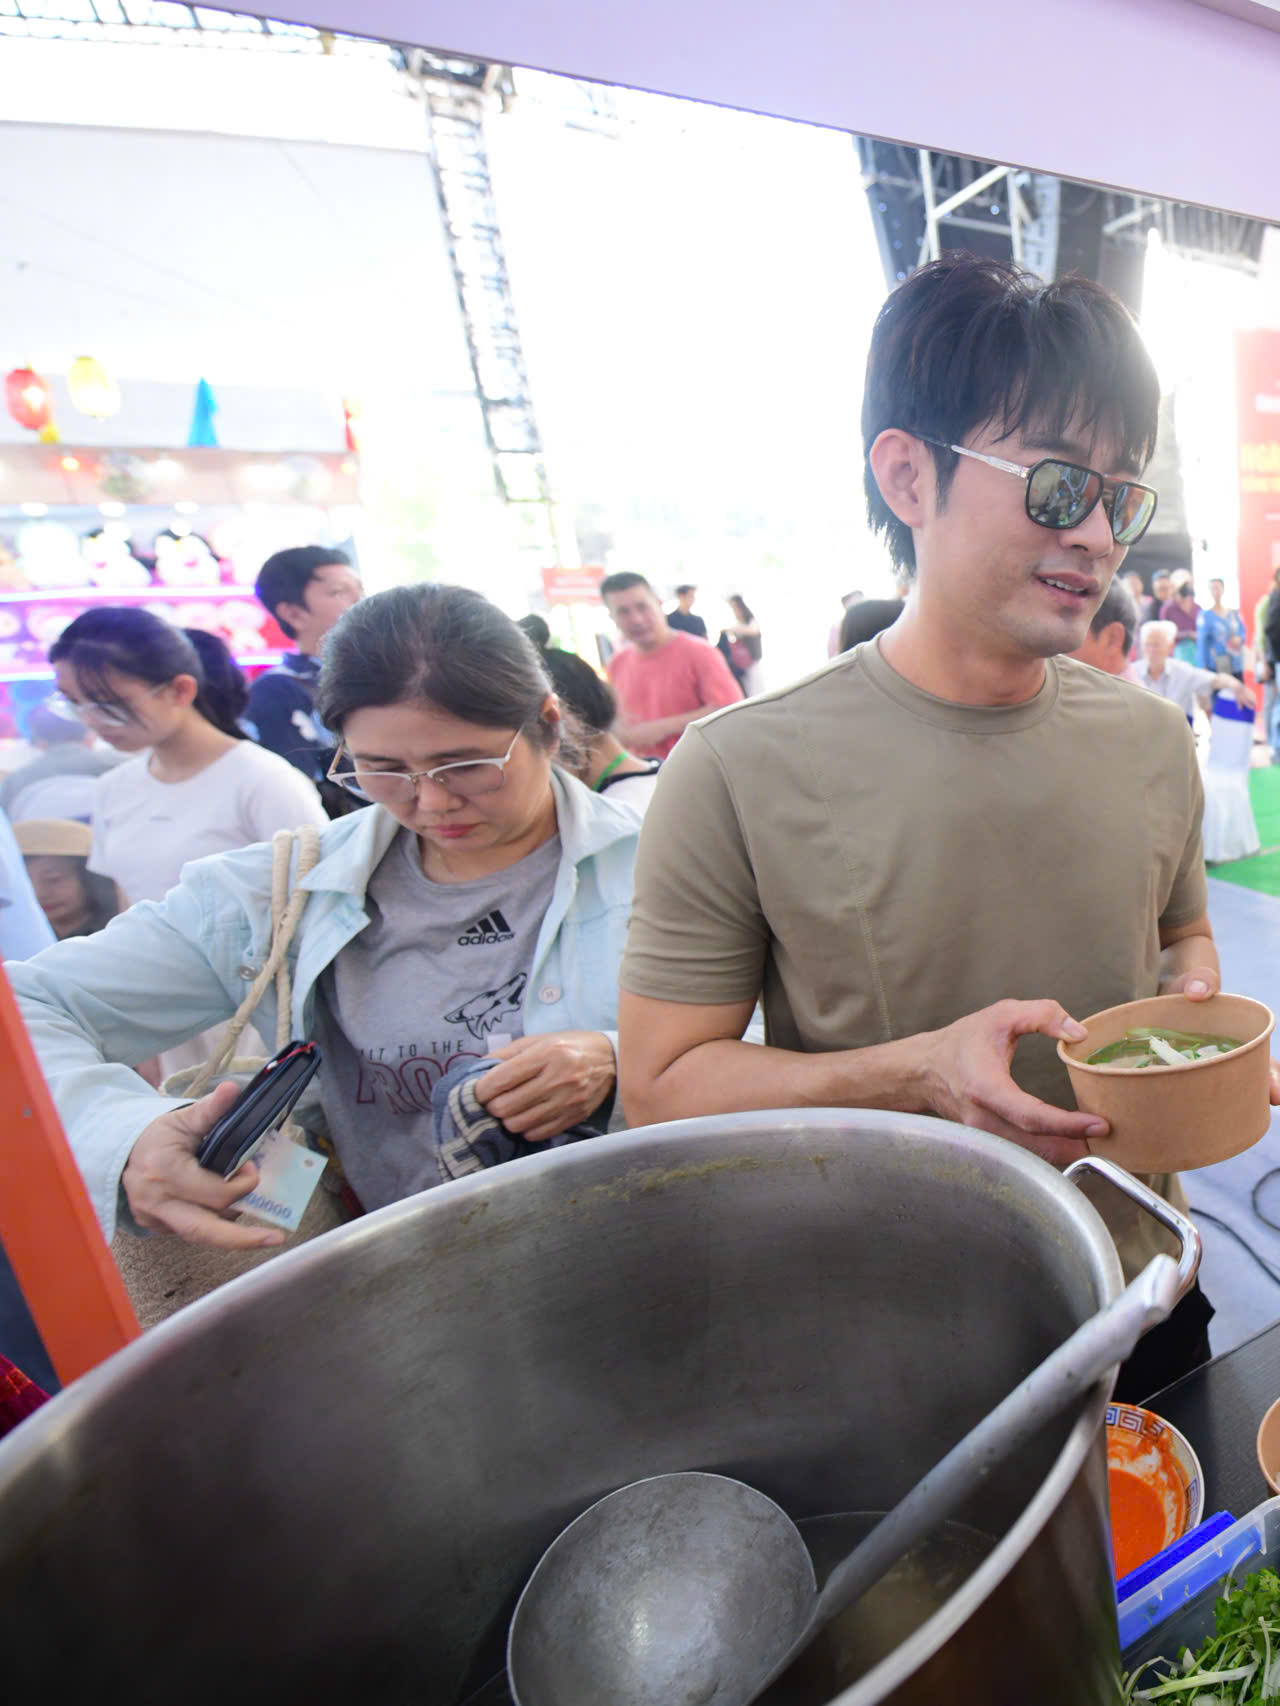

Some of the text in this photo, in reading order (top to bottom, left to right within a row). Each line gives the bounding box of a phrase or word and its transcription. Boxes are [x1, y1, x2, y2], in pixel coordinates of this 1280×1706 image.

[458, 931, 516, 946] adidas
[398, 1044, 417, 1058] TO
[432, 1039, 464, 1056] THE
